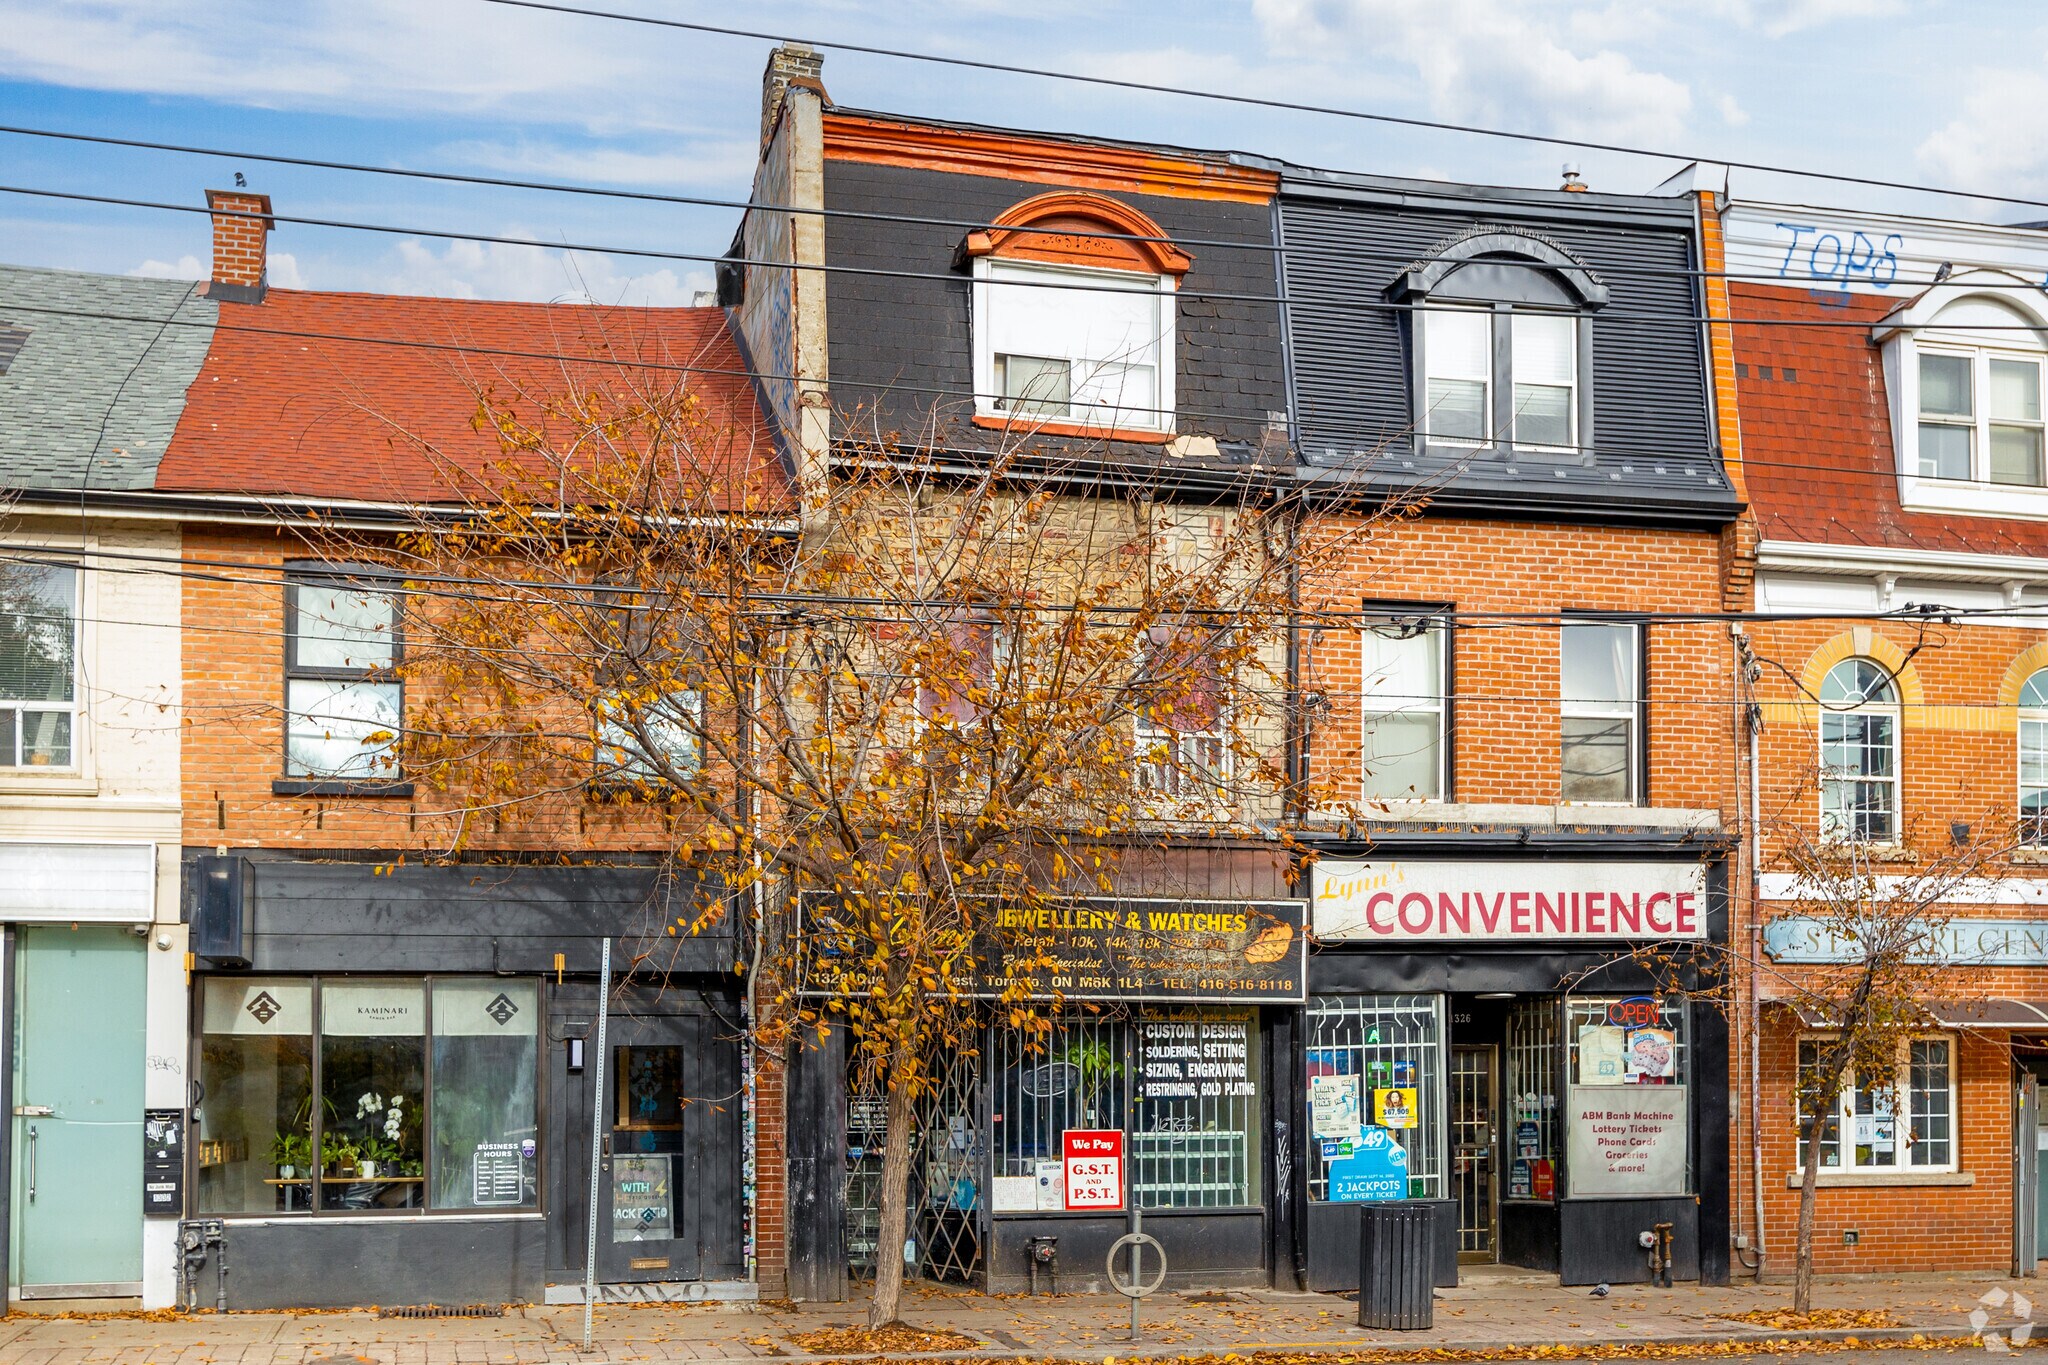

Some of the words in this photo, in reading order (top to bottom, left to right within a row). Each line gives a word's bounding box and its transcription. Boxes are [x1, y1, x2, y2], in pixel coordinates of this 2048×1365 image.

[1317, 862, 1405, 902] Lynn's
[1366, 892, 1696, 934] CONVENIENCE
[995, 909, 1118, 930] JEWELLERY
[1126, 911, 1142, 929] &
[1149, 912, 1247, 932] WATCHES
[1071, 936, 1097, 950] 10k,
[1052, 977, 1072, 987] ON
[1080, 977, 1111, 988] M6K
[1118, 977, 1143, 989] 1L4
[1199, 979, 1293, 991] 416-516-8118
[1610, 1003, 1659, 1024] OPEN
[1146, 1025, 1195, 1039] CUSTOM
[1202, 1025, 1246, 1039] DESIGN
[1146, 1046, 1200, 1059] SOLDERING,
[1204, 1044, 1246, 1058] SETTING
[1146, 1063, 1183, 1080] SIZING,
[1188, 1063, 1246, 1077] ENGRAVING
[1146, 1083, 1198, 1099] RESTRINGING,
[1201, 1082, 1221, 1096] GOLD
[1225, 1082, 1256, 1096] PLATING
[1582, 1112, 1603, 1120] ABM
[1606, 1111, 1631, 1120] Bank
[1634, 1111, 1674, 1120] Machine
[1593, 1125, 1627, 1135] Lottery
[1630, 1125, 1662, 1133] Tickets
[1072, 1139, 1090, 1150] We
[1093, 1139, 1114, 1151] Pay
[1598, 1138, 1627, 1146] Phone
[1630, 1138, 1656, 1146] Cards
[1389, 1150, 1408, 1163] NEW
[1606, 1151, 1648, 1159] Groceries
[1073, 1164, 1114, 1176] G.S.T.
[1618, 1164, 1645, 1172] more!
[622, 1182, 650, 1193] WITH
[1337, 1183, 1343, 1193] 2
[1347, 1181, 1401, 1192] JACKPOTS
[1074, 1188, 1115, 1200] P.S.T.
[613, 1208, 636, 1219] ACK
